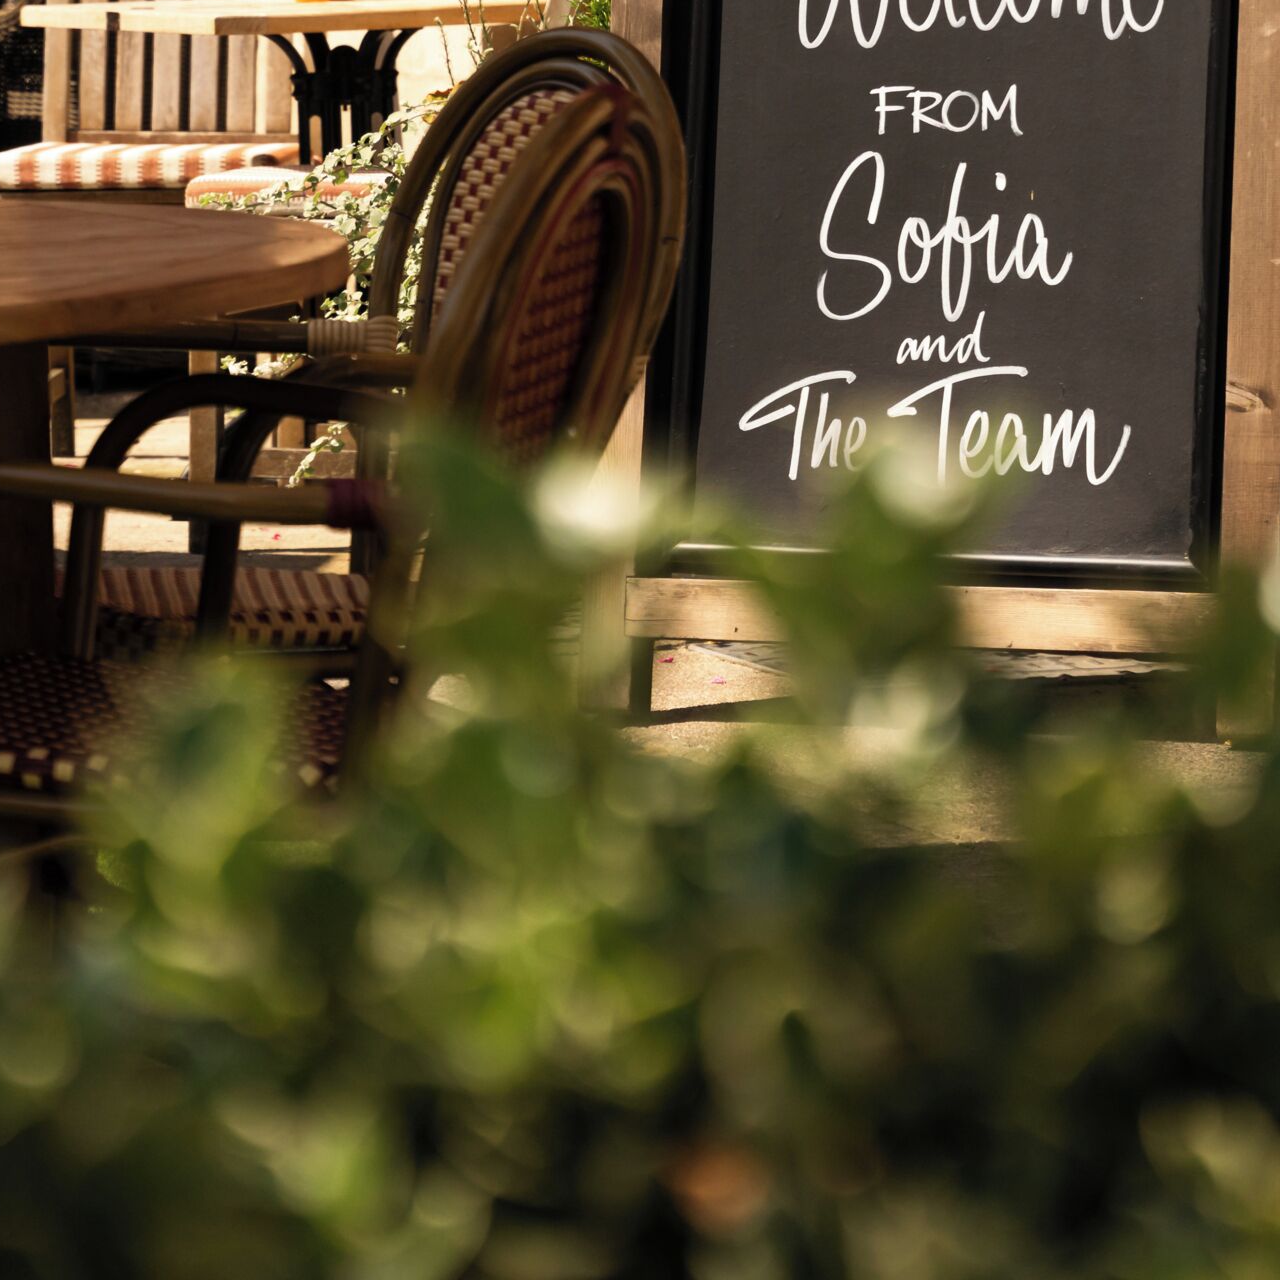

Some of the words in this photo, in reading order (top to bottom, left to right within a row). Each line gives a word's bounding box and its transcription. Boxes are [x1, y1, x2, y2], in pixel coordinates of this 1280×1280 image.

[869, 85, 1024, 136] FROM
[816, 150, 1073, 321] Sofia
[895, 311, 990, 364] and
[738, 370, 868, 482] The
[887, 365, 1131, 487] Team
